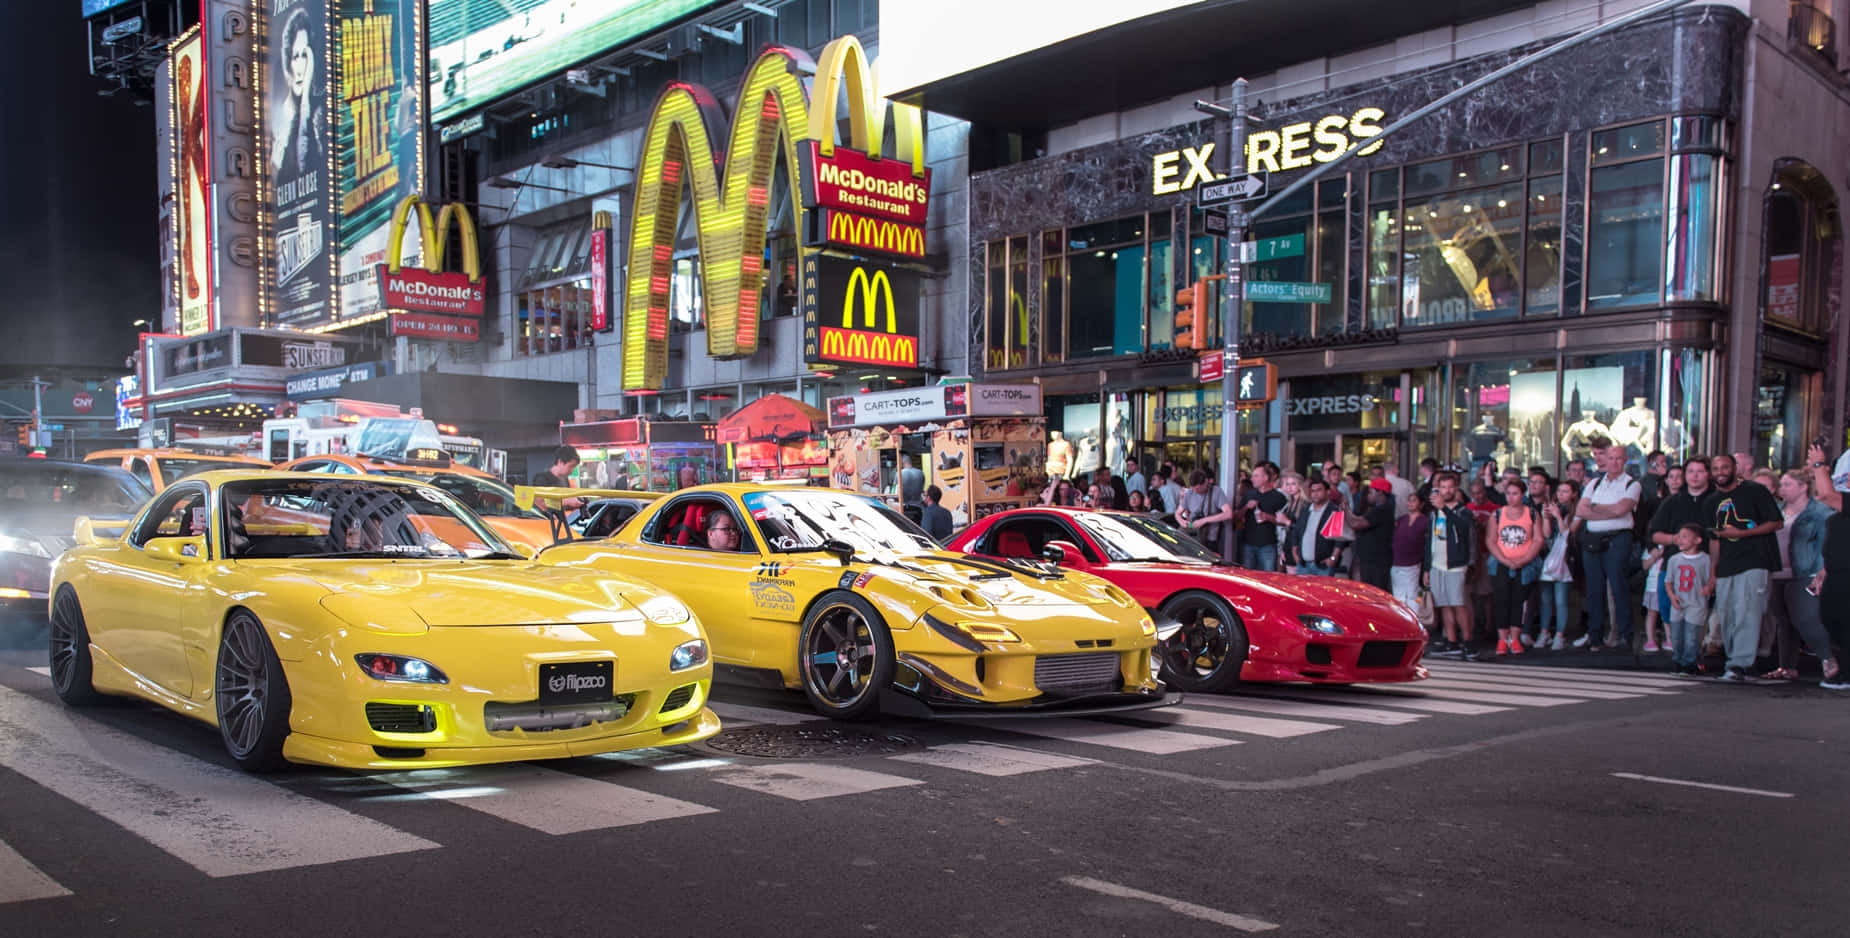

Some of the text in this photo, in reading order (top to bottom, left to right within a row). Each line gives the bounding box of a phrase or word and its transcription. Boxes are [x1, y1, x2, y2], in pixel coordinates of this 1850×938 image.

[341, 13, 394, 100] BRONX
[223, 10, 250, 268] PALACE
[351, 90, 391, 183] TALE
[1153, 107, 1385, 195] EXRESS
[819, 162, 927, 204] McDonald's
[1206, 182, 1247, 199] ONE WAY
[838, 190, 910, 216] Restaurant
[1269, 240, 1277, 257] 7
[388, 278, 483, 301] McDonald's
[1250, 280, 1326, 297] Actors' Equity
[403, 295, 467, 309] Restaurant
[396, 319, 426, 331] OPEN
[428, 322, 441, 331] 24
[289, 346, 331, 369] SUNSET
[286, 377, 318, 395] CHANGE
[350, 369, 368, 384] ATM
[72, 398, 94, 408] CNY
[1153, 404, 1223, 425] EXPRES
[1283, 394, 1375, 416] EXPRESS
[1677, 564, 1697, 593] B
